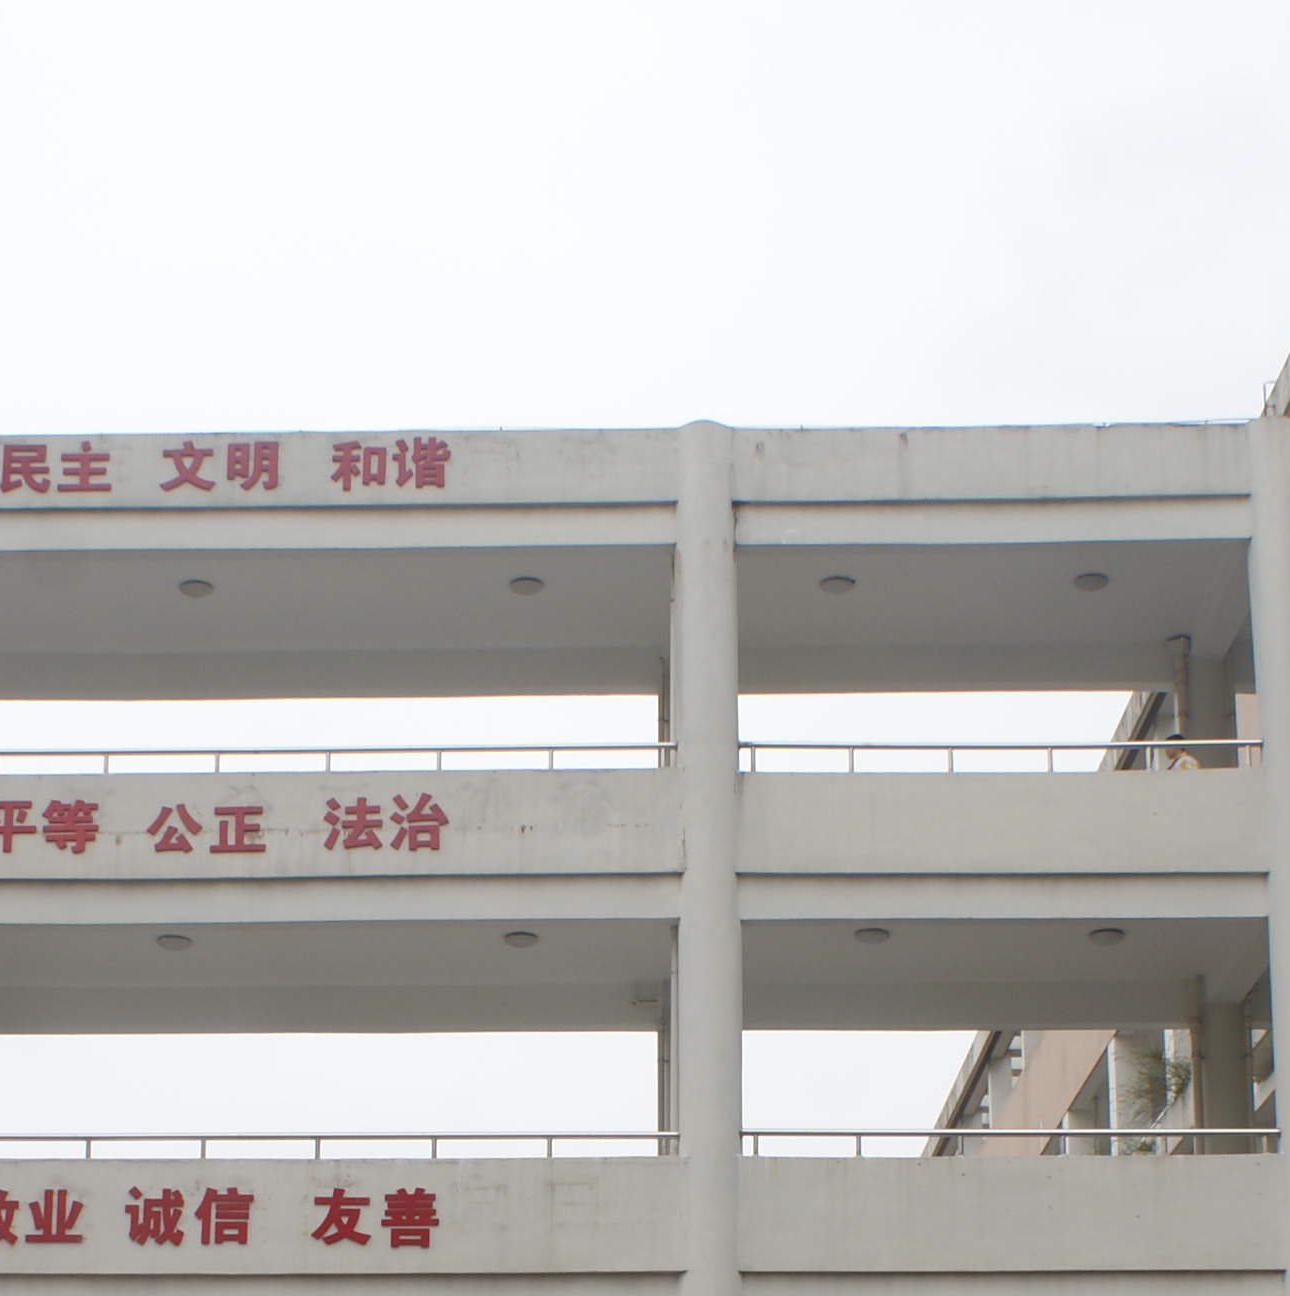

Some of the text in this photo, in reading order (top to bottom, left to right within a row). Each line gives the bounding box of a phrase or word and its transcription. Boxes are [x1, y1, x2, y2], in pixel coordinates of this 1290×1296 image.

[0, 442, 112, 494] 民主
[161, 440, 280, 493] 文明
[331, 436, 451, 492] 和谐
[147, 803, 266, 855] 公正
[323, 793, 449, 853] 法治
[124, 1186, 256, 1246] 诚信
[311, 1187, 441, 1249] 友善
